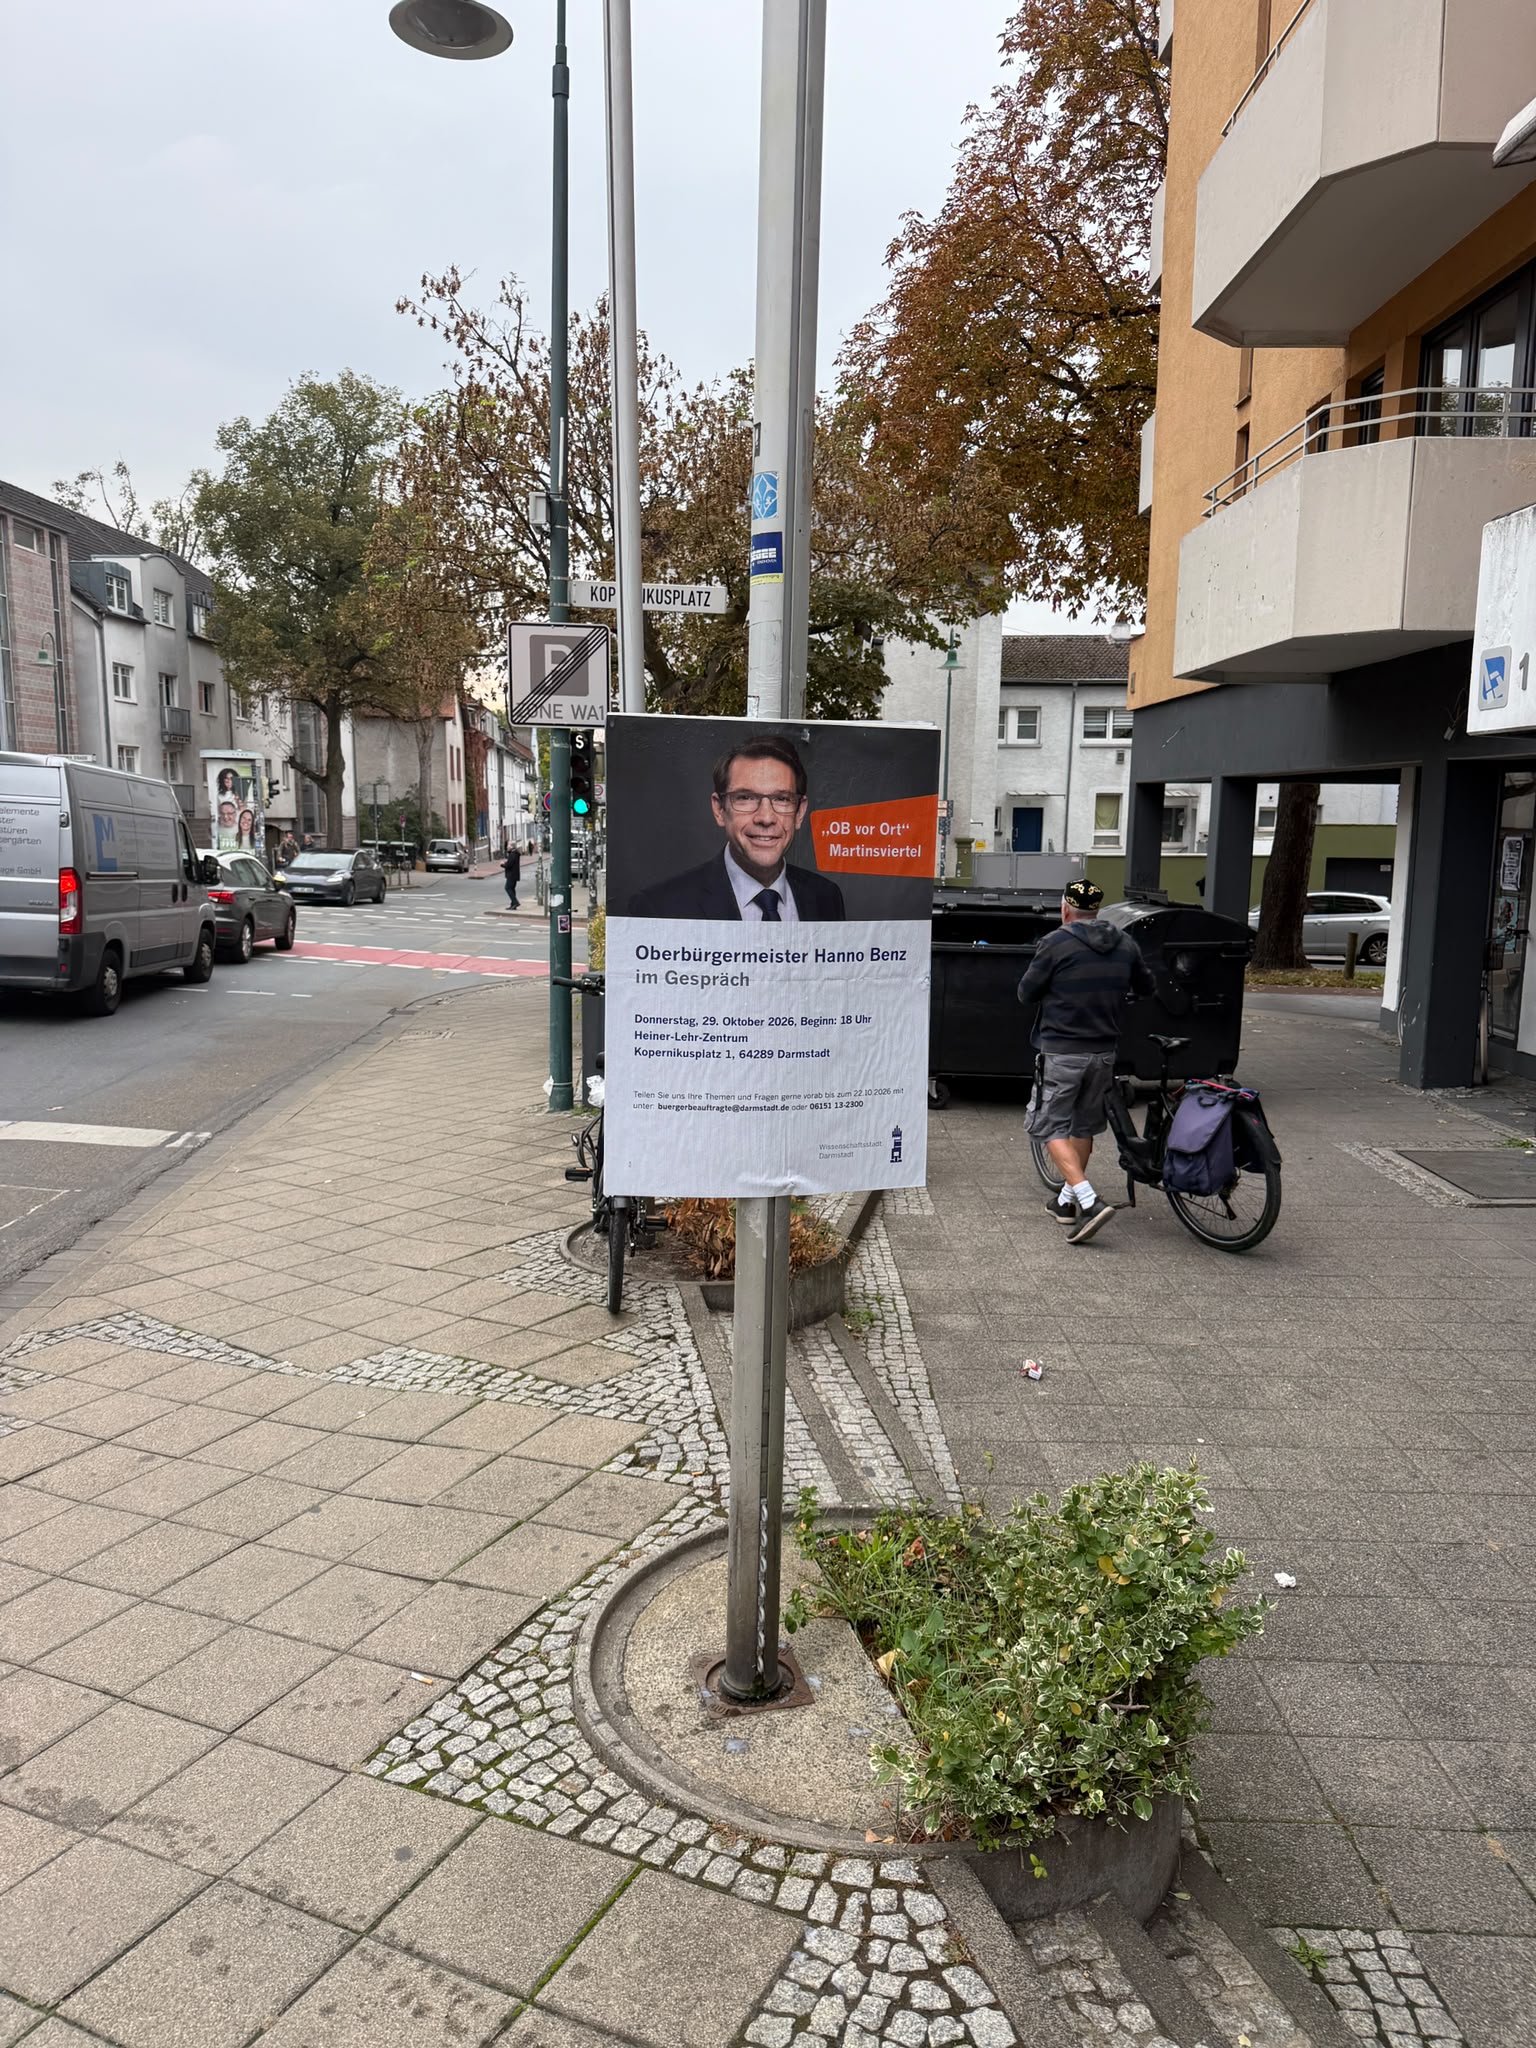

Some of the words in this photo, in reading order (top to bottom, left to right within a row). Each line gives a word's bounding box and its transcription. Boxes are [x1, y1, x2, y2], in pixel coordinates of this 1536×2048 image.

[590, 586, 711, 607] KOPIKUSPLATZ
[516, 702, 563, 719] NE
[570, 704, 604, 720] WA1
[575, 735, 585, 749] S
[855, 825, 875, 835] vor
[829, 843, 922, 858] Martinsviertel
[635, 945, 808, 966] Oberbürgermeister
[814, 948, 865, 963] Hanno
[870, 947, 907, 962] Benz
[636, 969, 658, 984] im
[665, 970, 750, 989] Gespräch
[634, 1014, 699, 1027] Donnerstag,
[702, 1016, 719, 1026] 29.
[722, 1016, 765, 1026] Oktober
[767, 1016, 797, 1028] 2026,
[800, 1015, 837, 1027] Beginn:
[840, 1015, 853, 1025] 18
[855, 1014, 872, 1024] Uhr
[634, 1030, 749, 1042] Heiner-Lehr-Zentrum
[634, 1047, 722, 1060] Kopernikusplatz
[725, 1050, 735, 1060] 1,
[738, 1049, 774, 1059] 64289
[777, 1048, 831, 1059] Darmstadt
[633, 1091, 656, 1099] Teilen
[657, 1091, 669, 1099] Sie
[688, 1092, 702, 1100] Ihre
[705, 1093, 735, 1101] Themen
[737, 1093, 751, 1101] und
[754, 1093, 779, 1102] Fragen
[781, 1094, 801, 1102] gerne
[803, 1092, 822, 1100] vorab
[824, 1091, 835, 1099] bis
[633, 1102, 655, 1110] unter:
[658, 1102, 790, 1112] buergerbeauftragte@darmstadt.de
[809, 1102, 832, 1110] 06151
[834, 1101, 864, 1109] 13-2300
[819, 1141, 883, 1150] Wissenschaftsstadt
[819, 1151, 854, 1160] Darmstadt
